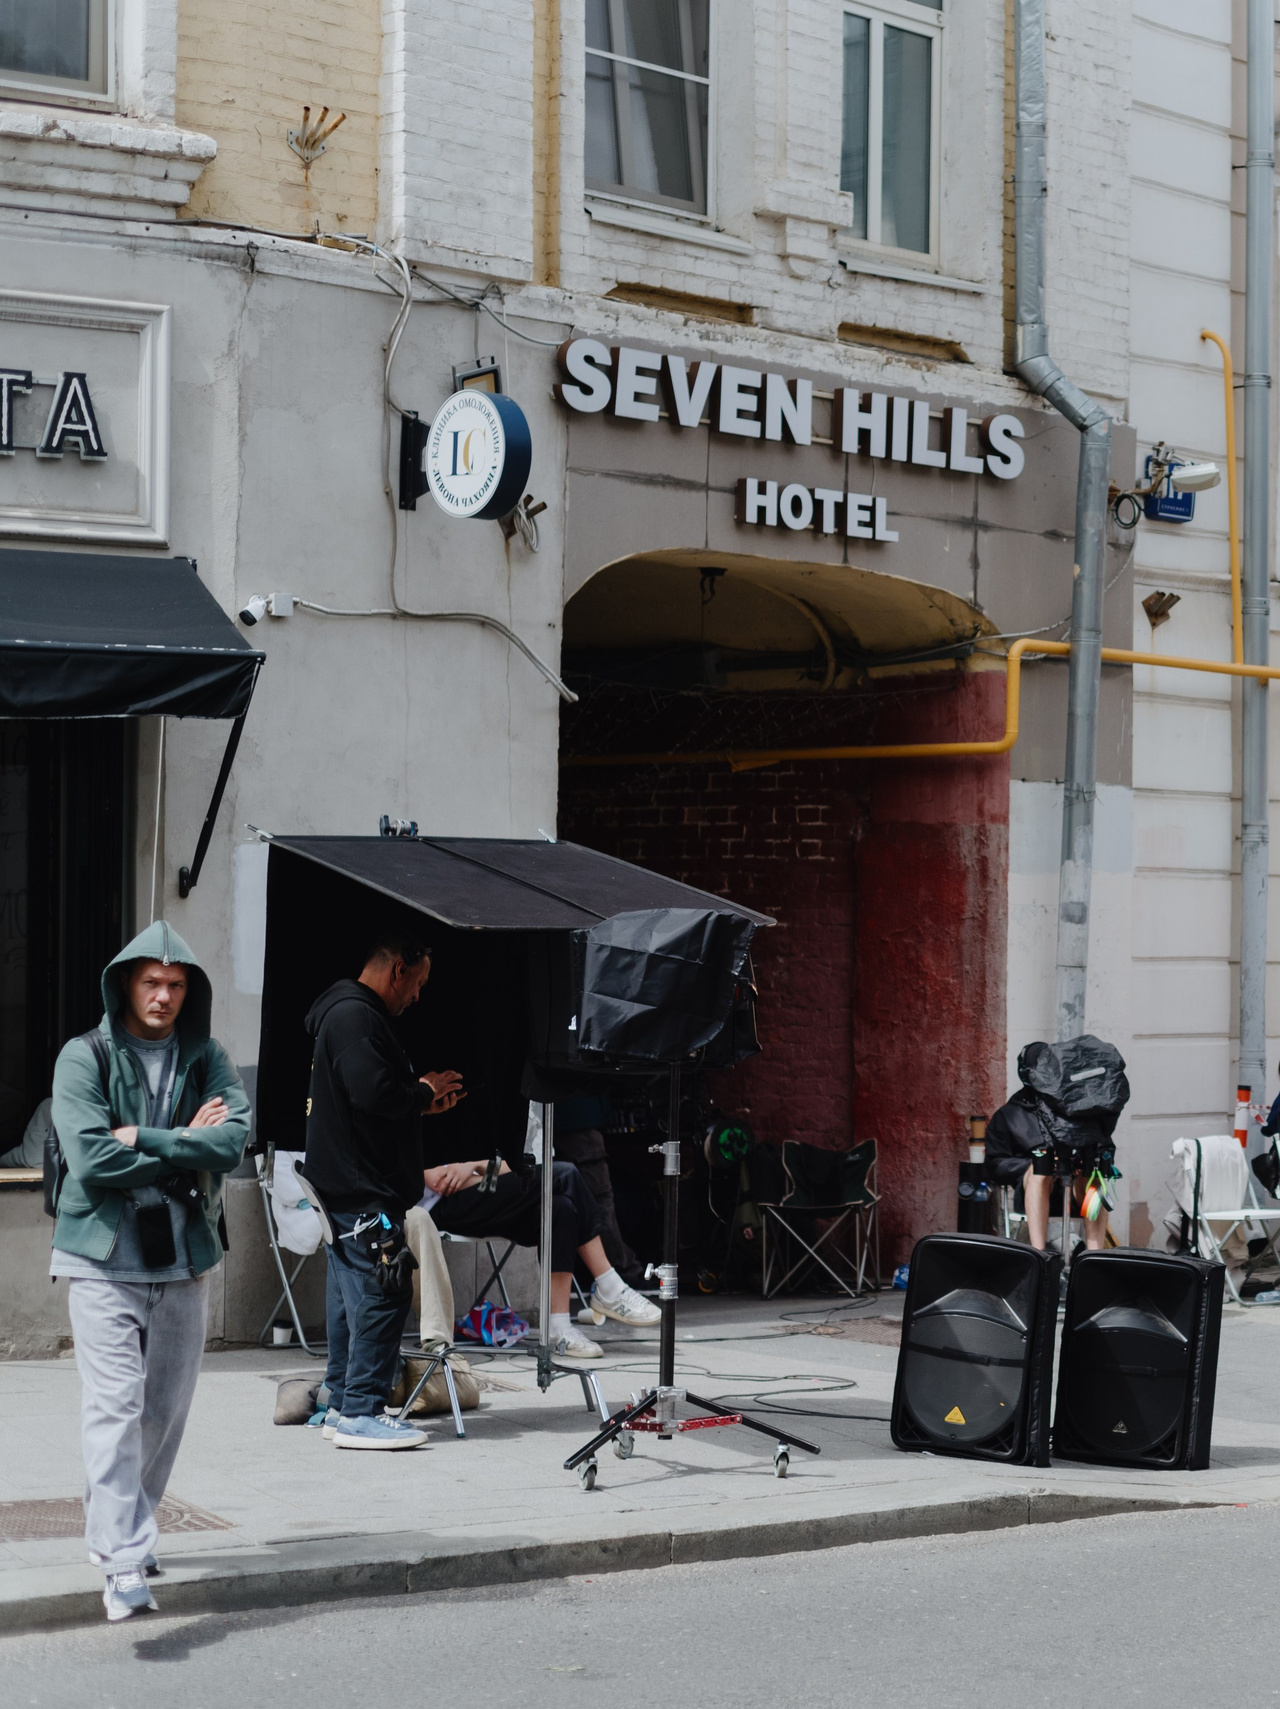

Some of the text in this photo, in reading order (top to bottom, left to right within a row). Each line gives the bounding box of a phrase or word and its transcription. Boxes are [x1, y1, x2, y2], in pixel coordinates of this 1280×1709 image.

[431, 397, 500, 459] КЛИНИКА ОМОЛОЖЕНИЯ
[559, 338, 1026, 480] SEVEN HILLS
[432, 464, 498, 508] ЛЕВОНА ЧАХОЯНА
[742, 477, 899, 543] HOTEL
